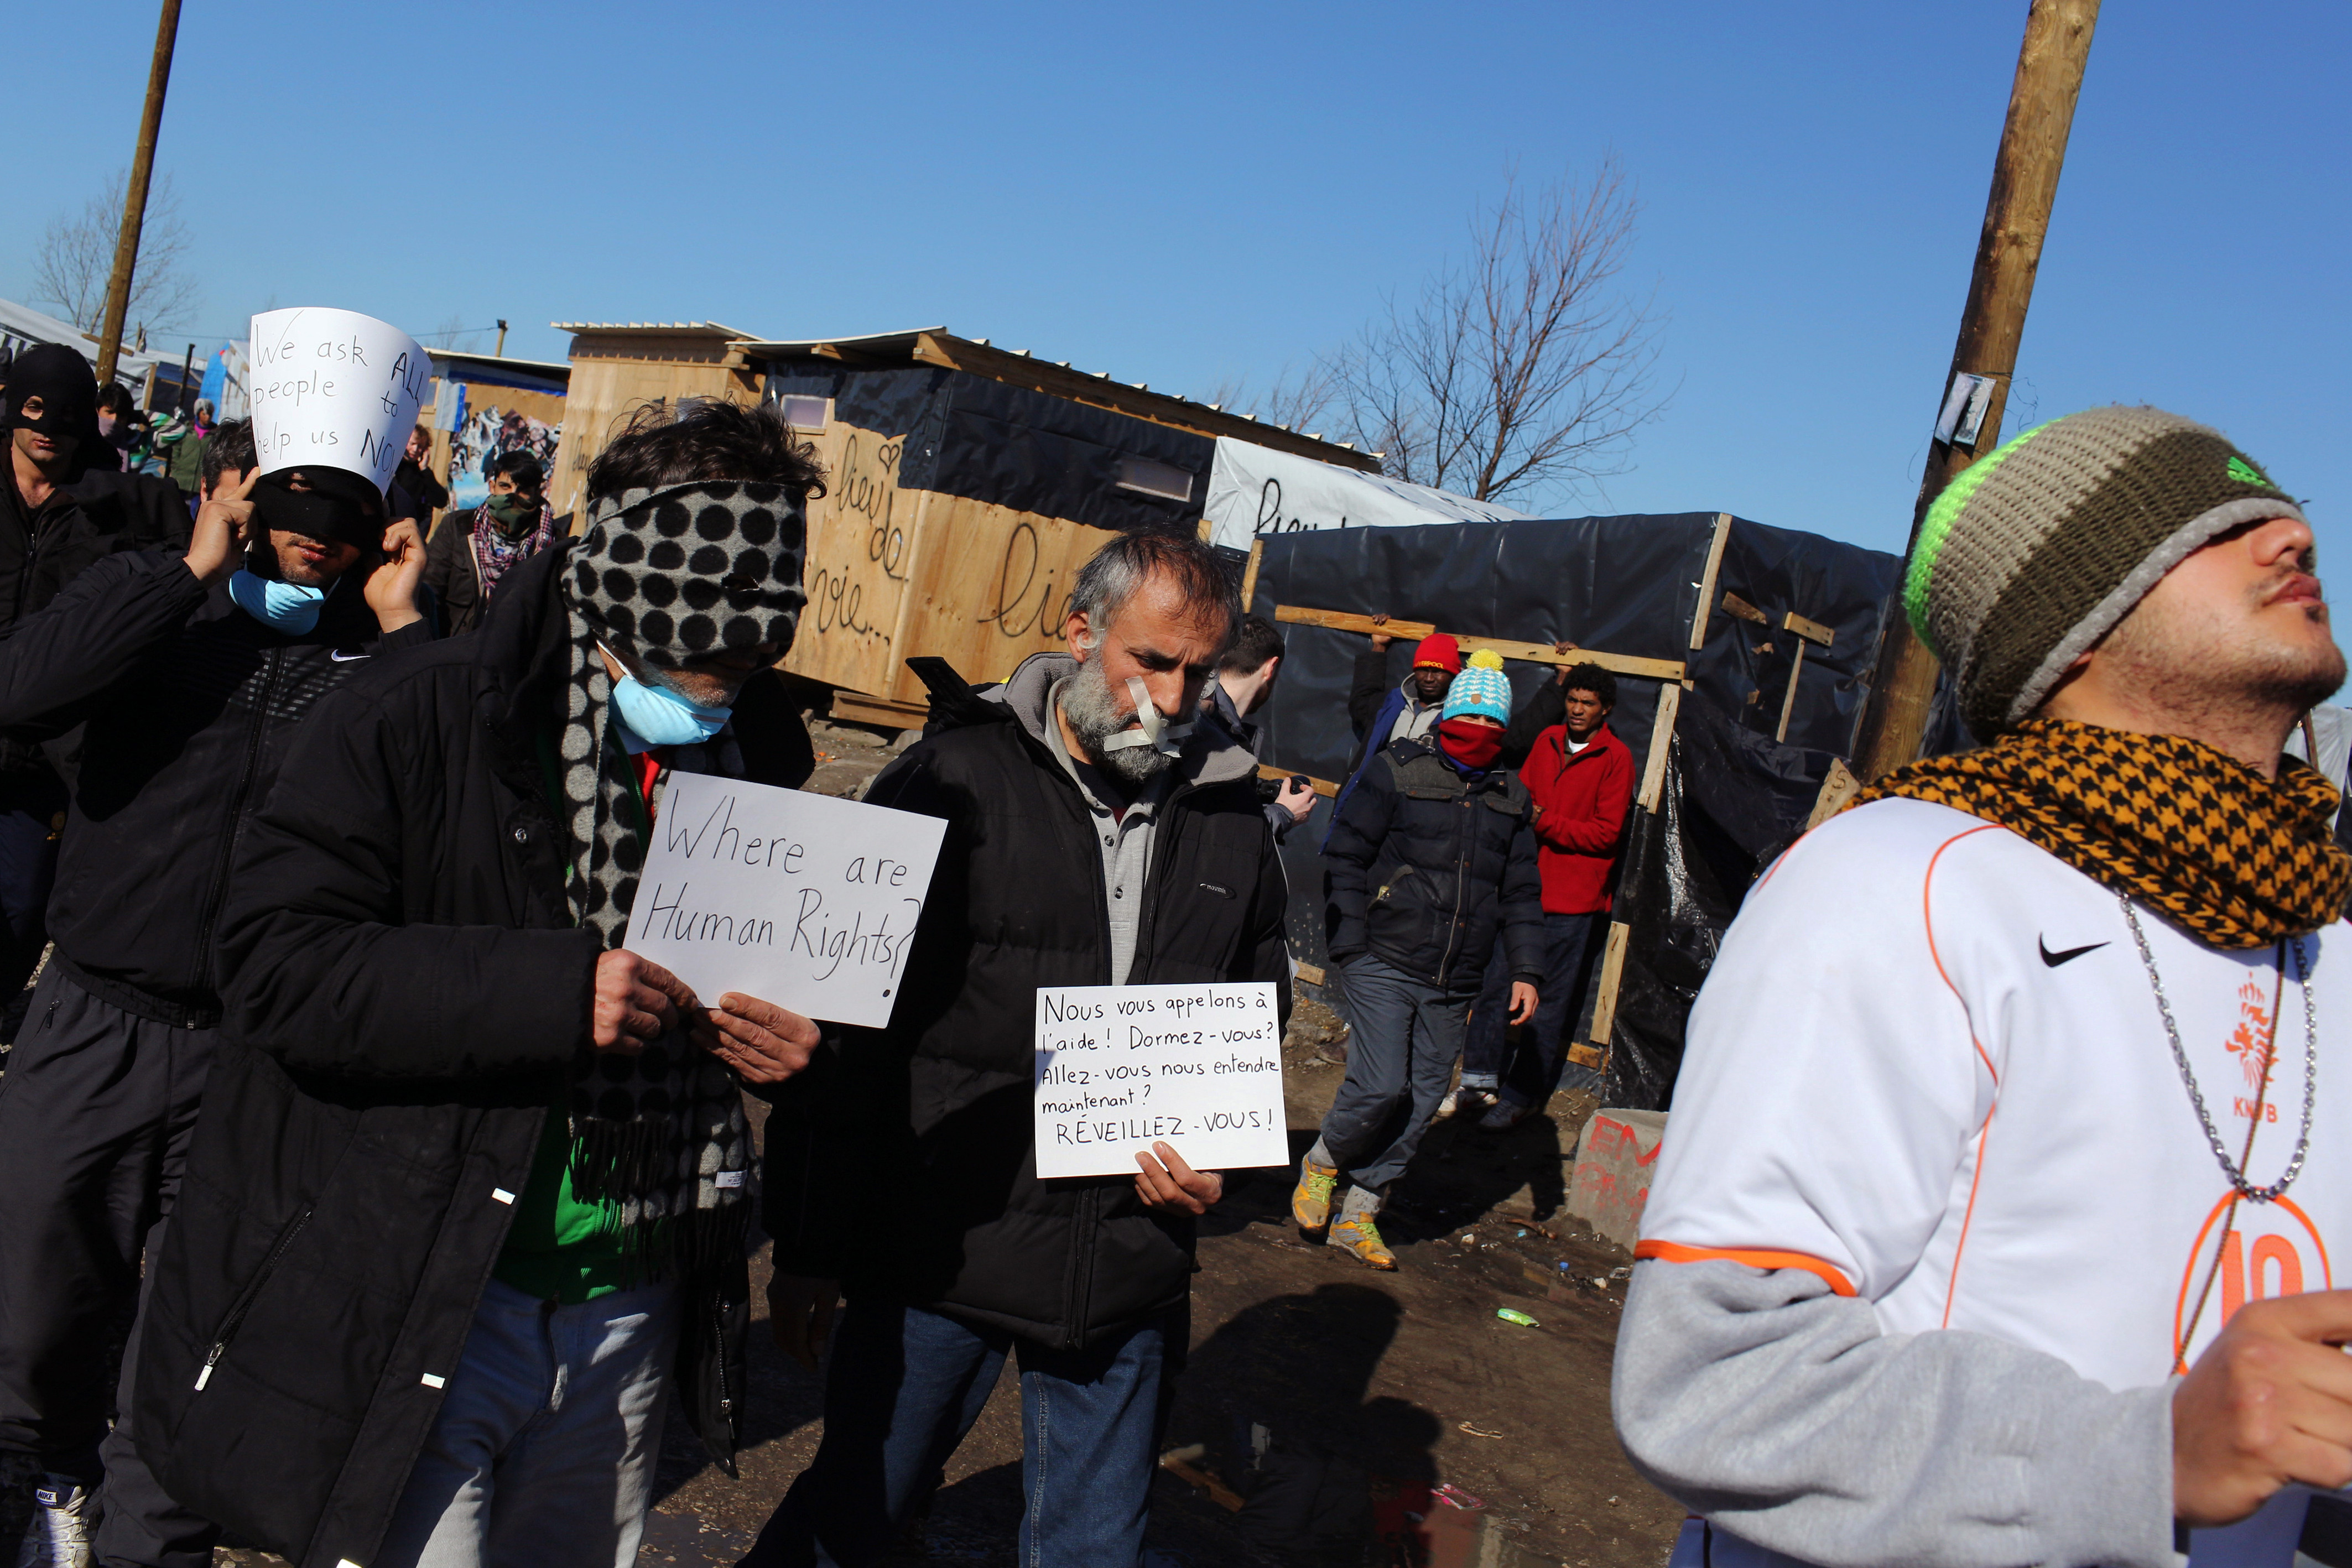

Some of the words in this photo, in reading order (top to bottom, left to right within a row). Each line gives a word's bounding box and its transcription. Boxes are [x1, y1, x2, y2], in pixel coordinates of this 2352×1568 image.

[256, 309, 305, 367] We
[318, 335, 368, 367] ask
[391, 352, 423, 408] ALL
[254, 369, 340, 420] people
[381, 390, 398, 417] to
[257, 421, 291, 460] help
[311, 430, 339, 445] us
[835, 434, 884, 519] lieu
[870, 491, 909, 583] de
[668, 789, 804, 874] Where
[846, 857, 907, 886] are
[642, 882, 773, 945] Human
[790, 888, 921, 998] Rights?
[1044, 993, 1104, 1024] Nous
[1117, 998, 1155, 1015] vous
[1165, 989, 1246, 1019] appelons
[1256, 992, 1268, 1009] à
[1042, 1064, 1152, 1085] Allez-vous
[1162, 1061, 1205, 1076] nous
[1214, 1053, 1279, 1075] entendre
[38, 1491, 53, 1499] NIKE
